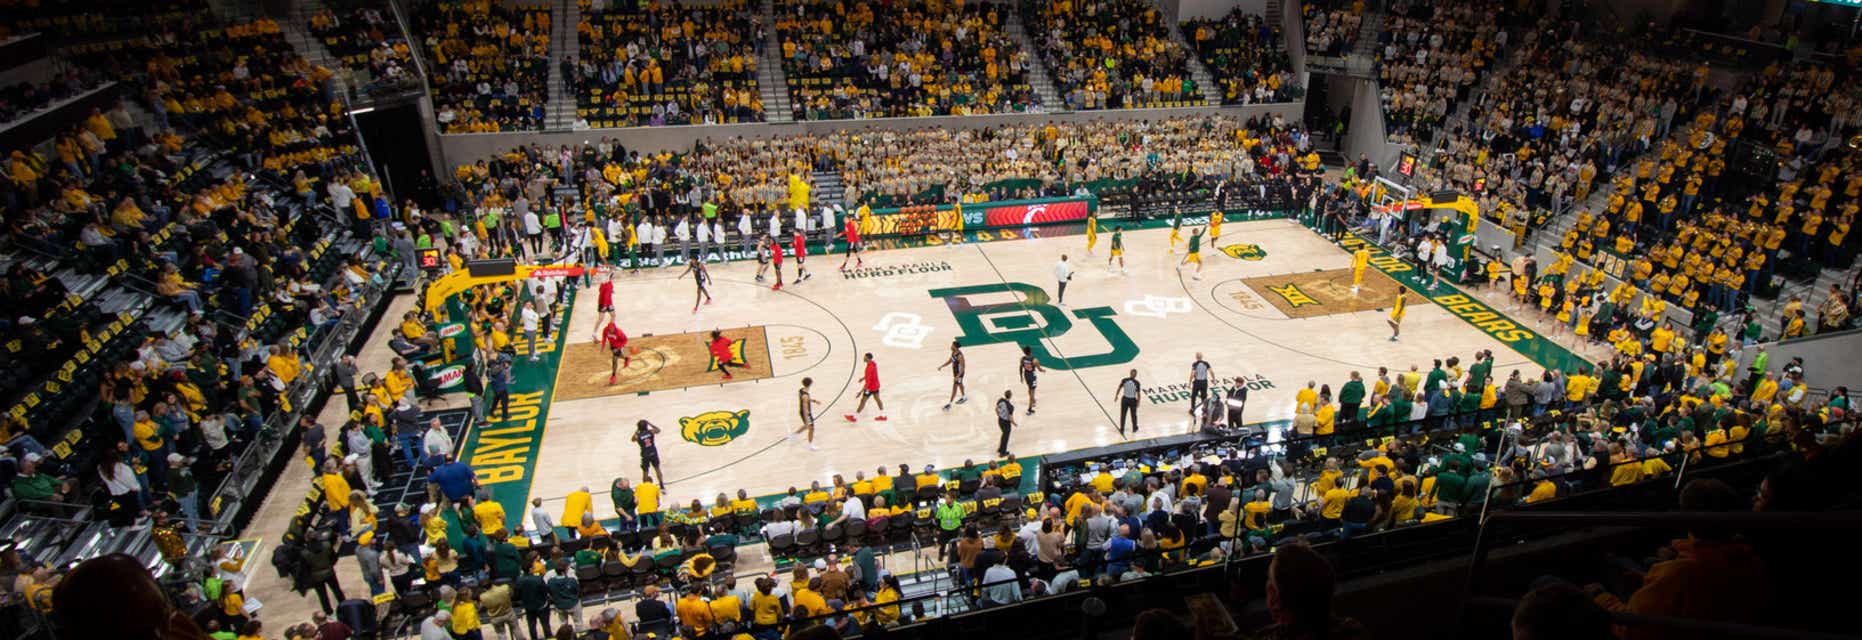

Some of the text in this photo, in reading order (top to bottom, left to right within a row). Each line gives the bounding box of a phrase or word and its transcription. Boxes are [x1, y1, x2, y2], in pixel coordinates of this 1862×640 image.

[962, 208, 984, 224] VS
[422, 256, 436, 267] 30
[840, 266, 883, 274] MARK
[902, 260, 949, 270] PAULA
[843, 264, 953, 280] HURD FLOOR
[1433, 293, 1534, 342] BEARS
[1142, 382, 1190, 395] MARK
[1147, 379, 1277, 405] HUR FLOR
